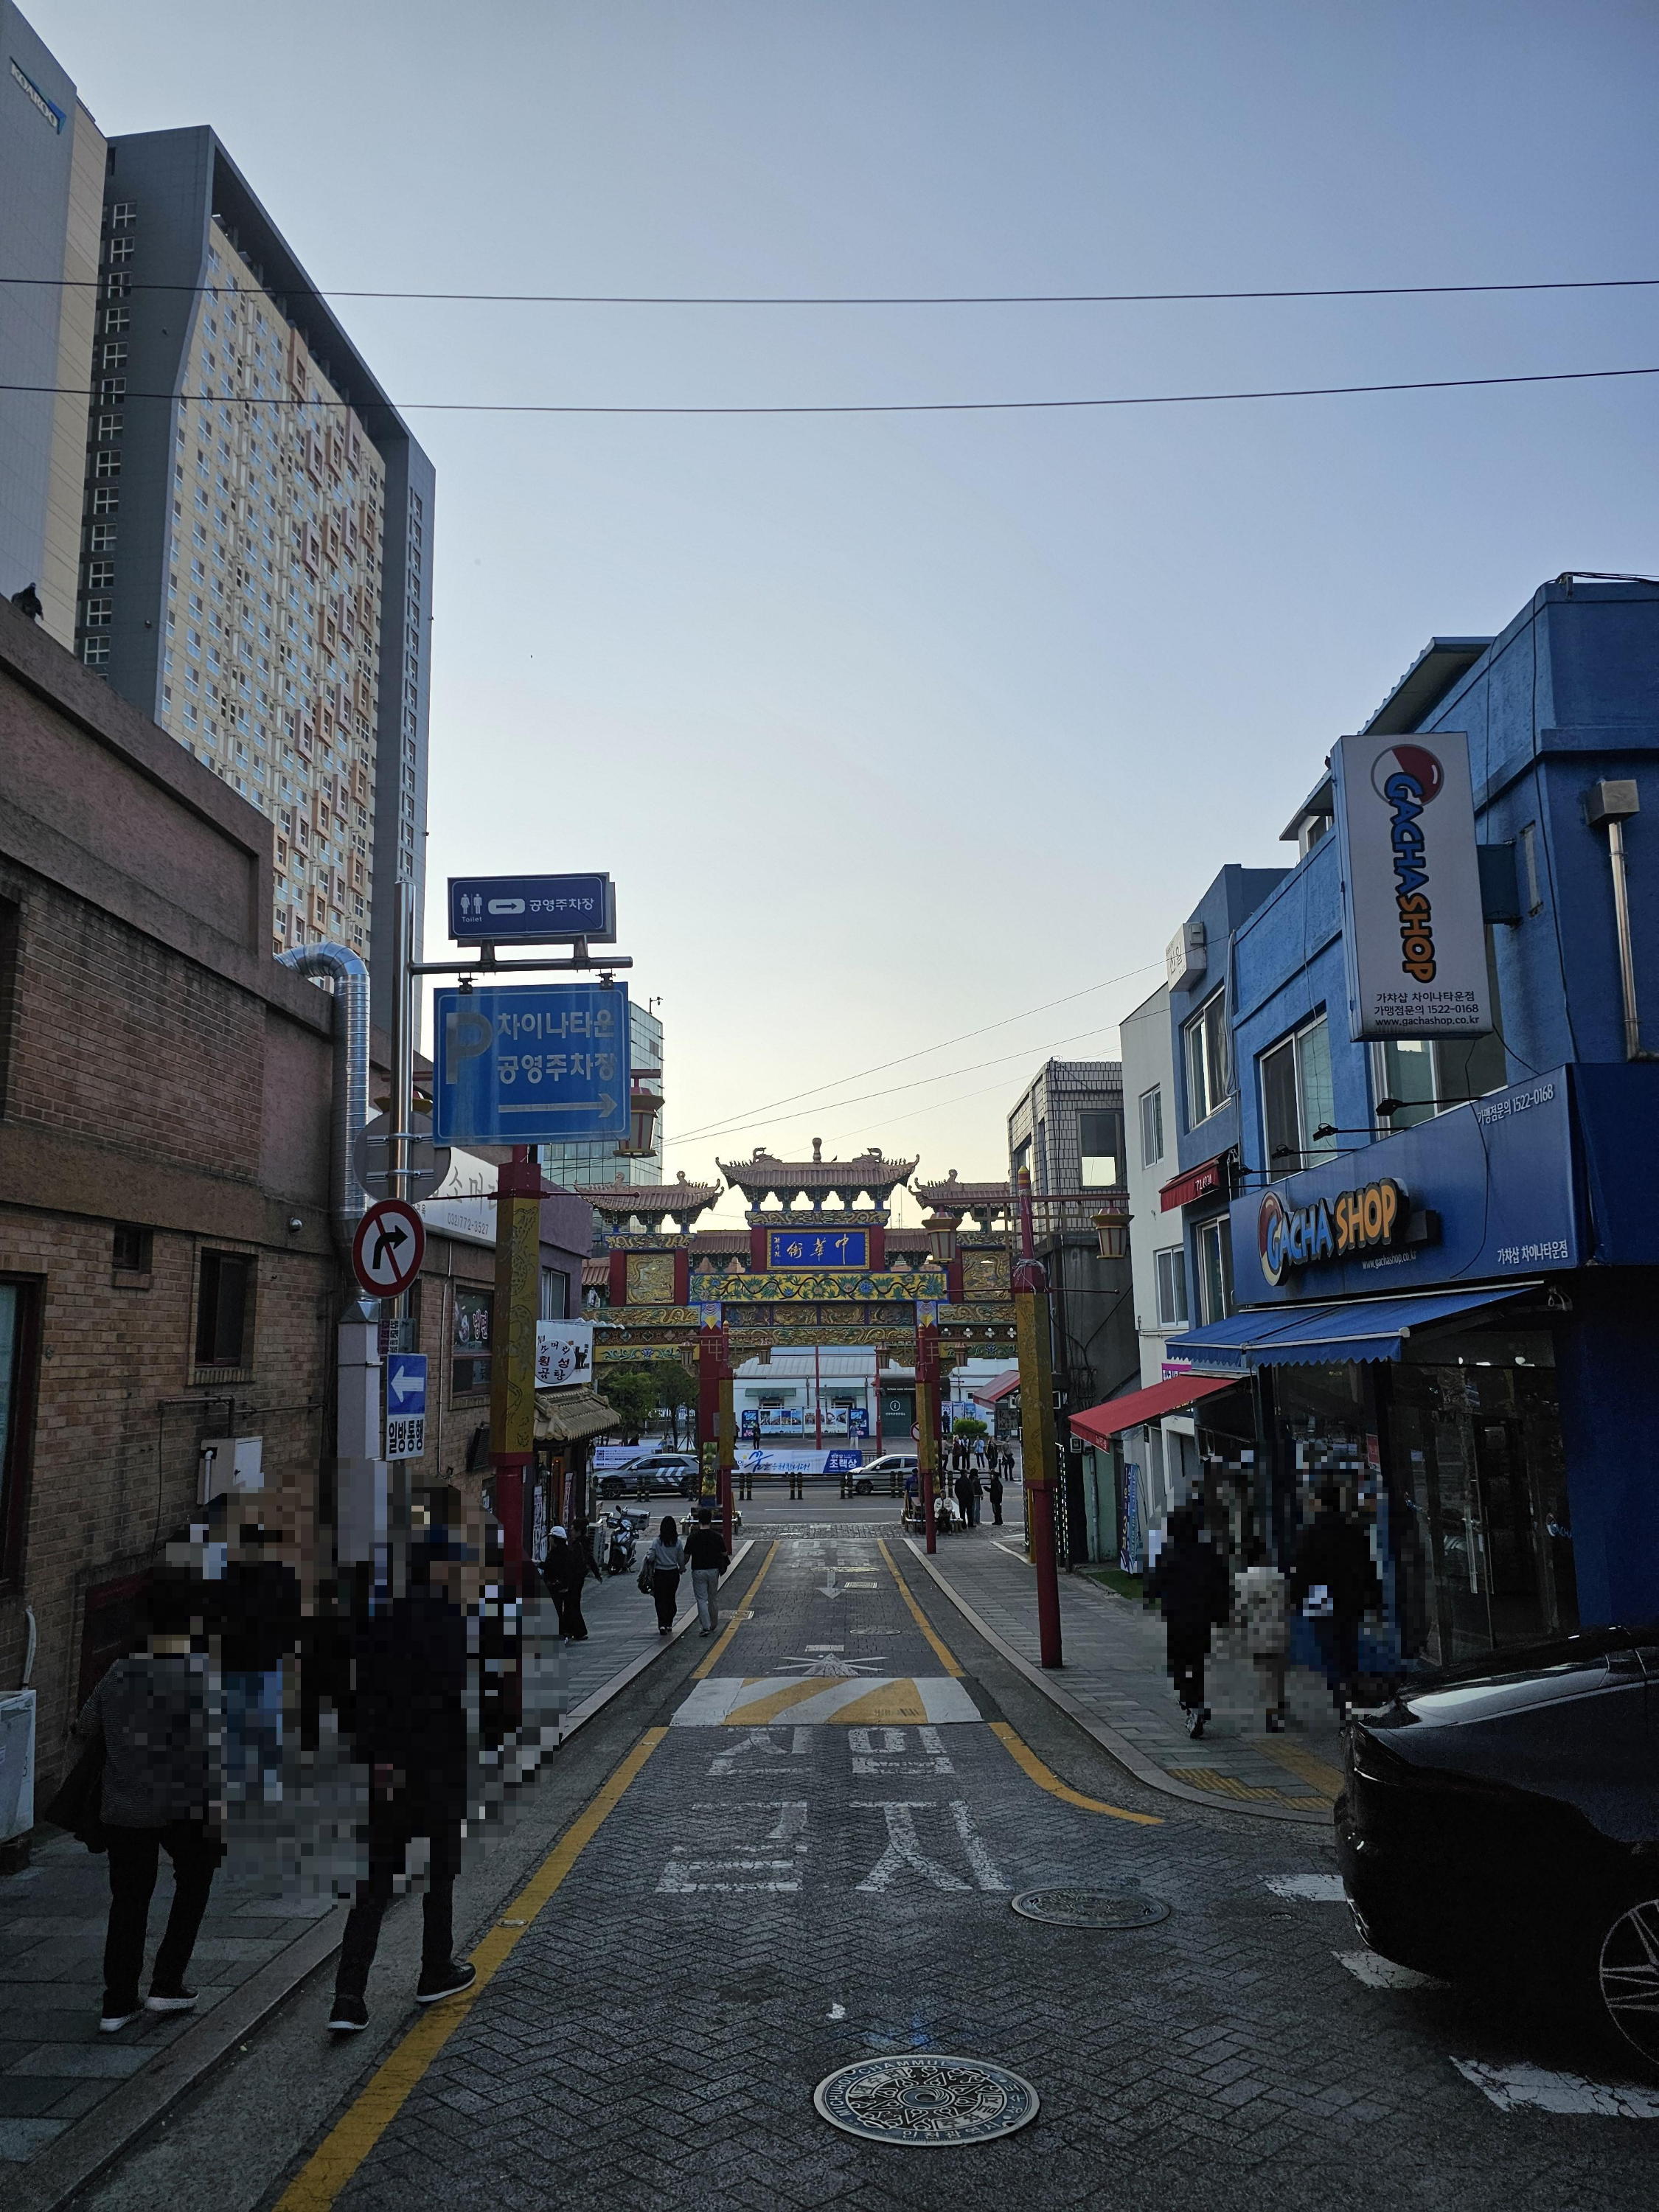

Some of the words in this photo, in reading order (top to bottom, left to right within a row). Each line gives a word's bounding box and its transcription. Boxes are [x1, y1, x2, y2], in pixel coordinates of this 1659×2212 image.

[10, 63, 58, 128] KOAROO
[529, 897, 594, 912] 공영주차장
[1374, 1005, 1425, 1016] 가맹점문의
[1427, 1004, 1479, 1014] 1522-0168
[1377, 992, 1408, 1003] 가챠샵
[1412, 990, 1475, 1003] 차이나타운점
[498, 1009, 616, 1041] 차이나타운
[1375, 1015, 1480, 1026] www.gachashop.co.kr
[446, 1011, 493, 1085] P
[498, 1051, 616, 1085] 공영주차장
[1478, 1099, 1511, 1125] 가맹점문의
[1512, 1084, 1554, 1113] 1522-0168
[448, 1212, 489, 1235] 032)772-3527
[1498, 1245, 1520, 1264] 가챠샵
[1522, 1239, 1568, 1262] 차이나타운점
[388, 1419, 424, 1455] 일방통행
[705, 1725, 956, 1776] 진입
[654, 1800, 1012, 1893] 금지
[828, 2076, 859, 2117] MICHUHOL
[858, 2059, 949, 2075] CHAMMUL
[939, 2096, 1001, 2129] 주차금지
